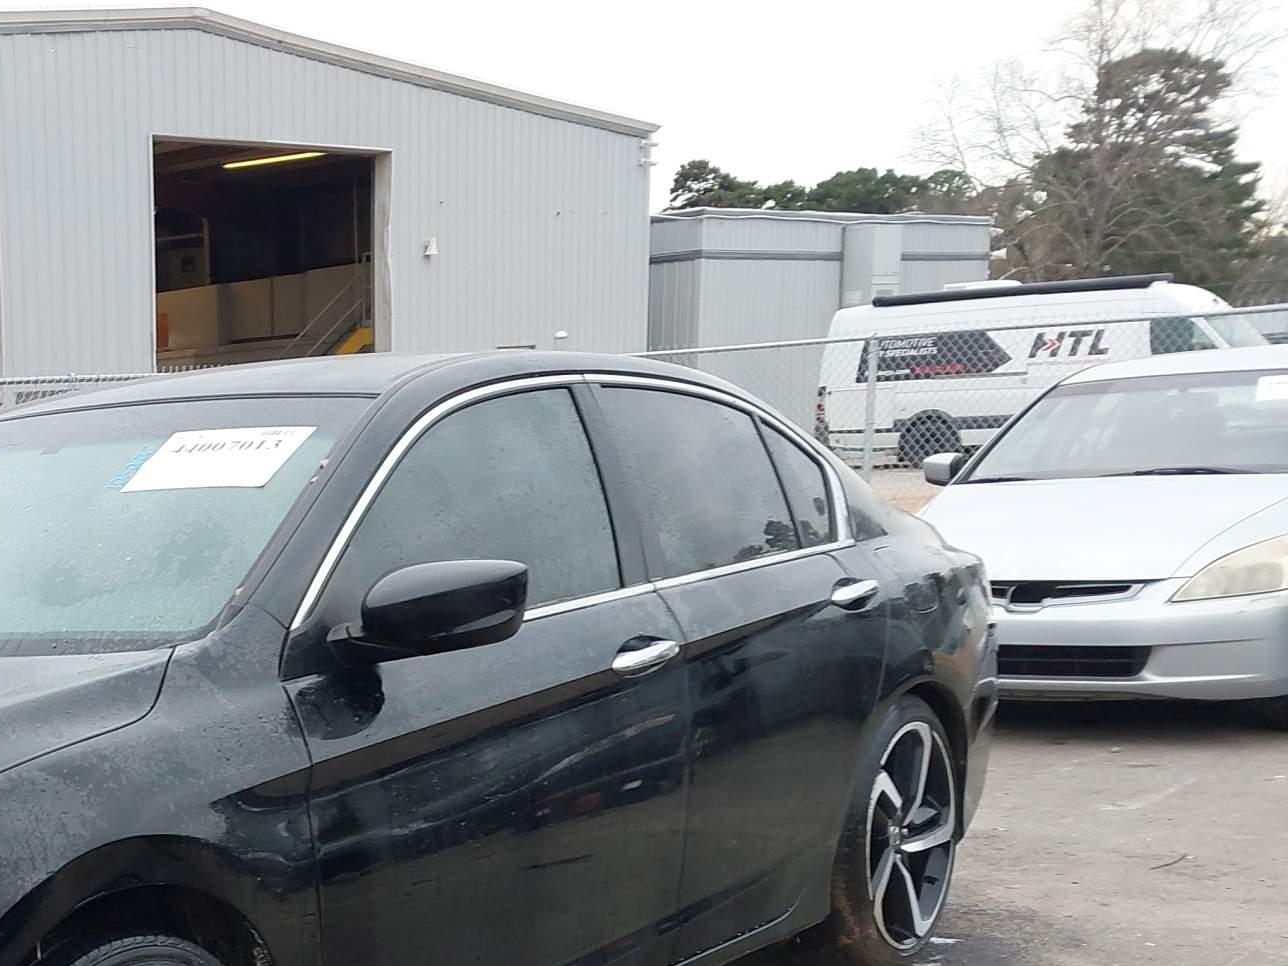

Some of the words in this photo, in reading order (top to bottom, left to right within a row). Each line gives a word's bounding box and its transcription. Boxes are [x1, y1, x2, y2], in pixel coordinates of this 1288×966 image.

[878, 337, 937, 350] UTOMOTIVE
[1028, 329, 1111, 358] HTL
[169, 439, 282, 453] 44007013
